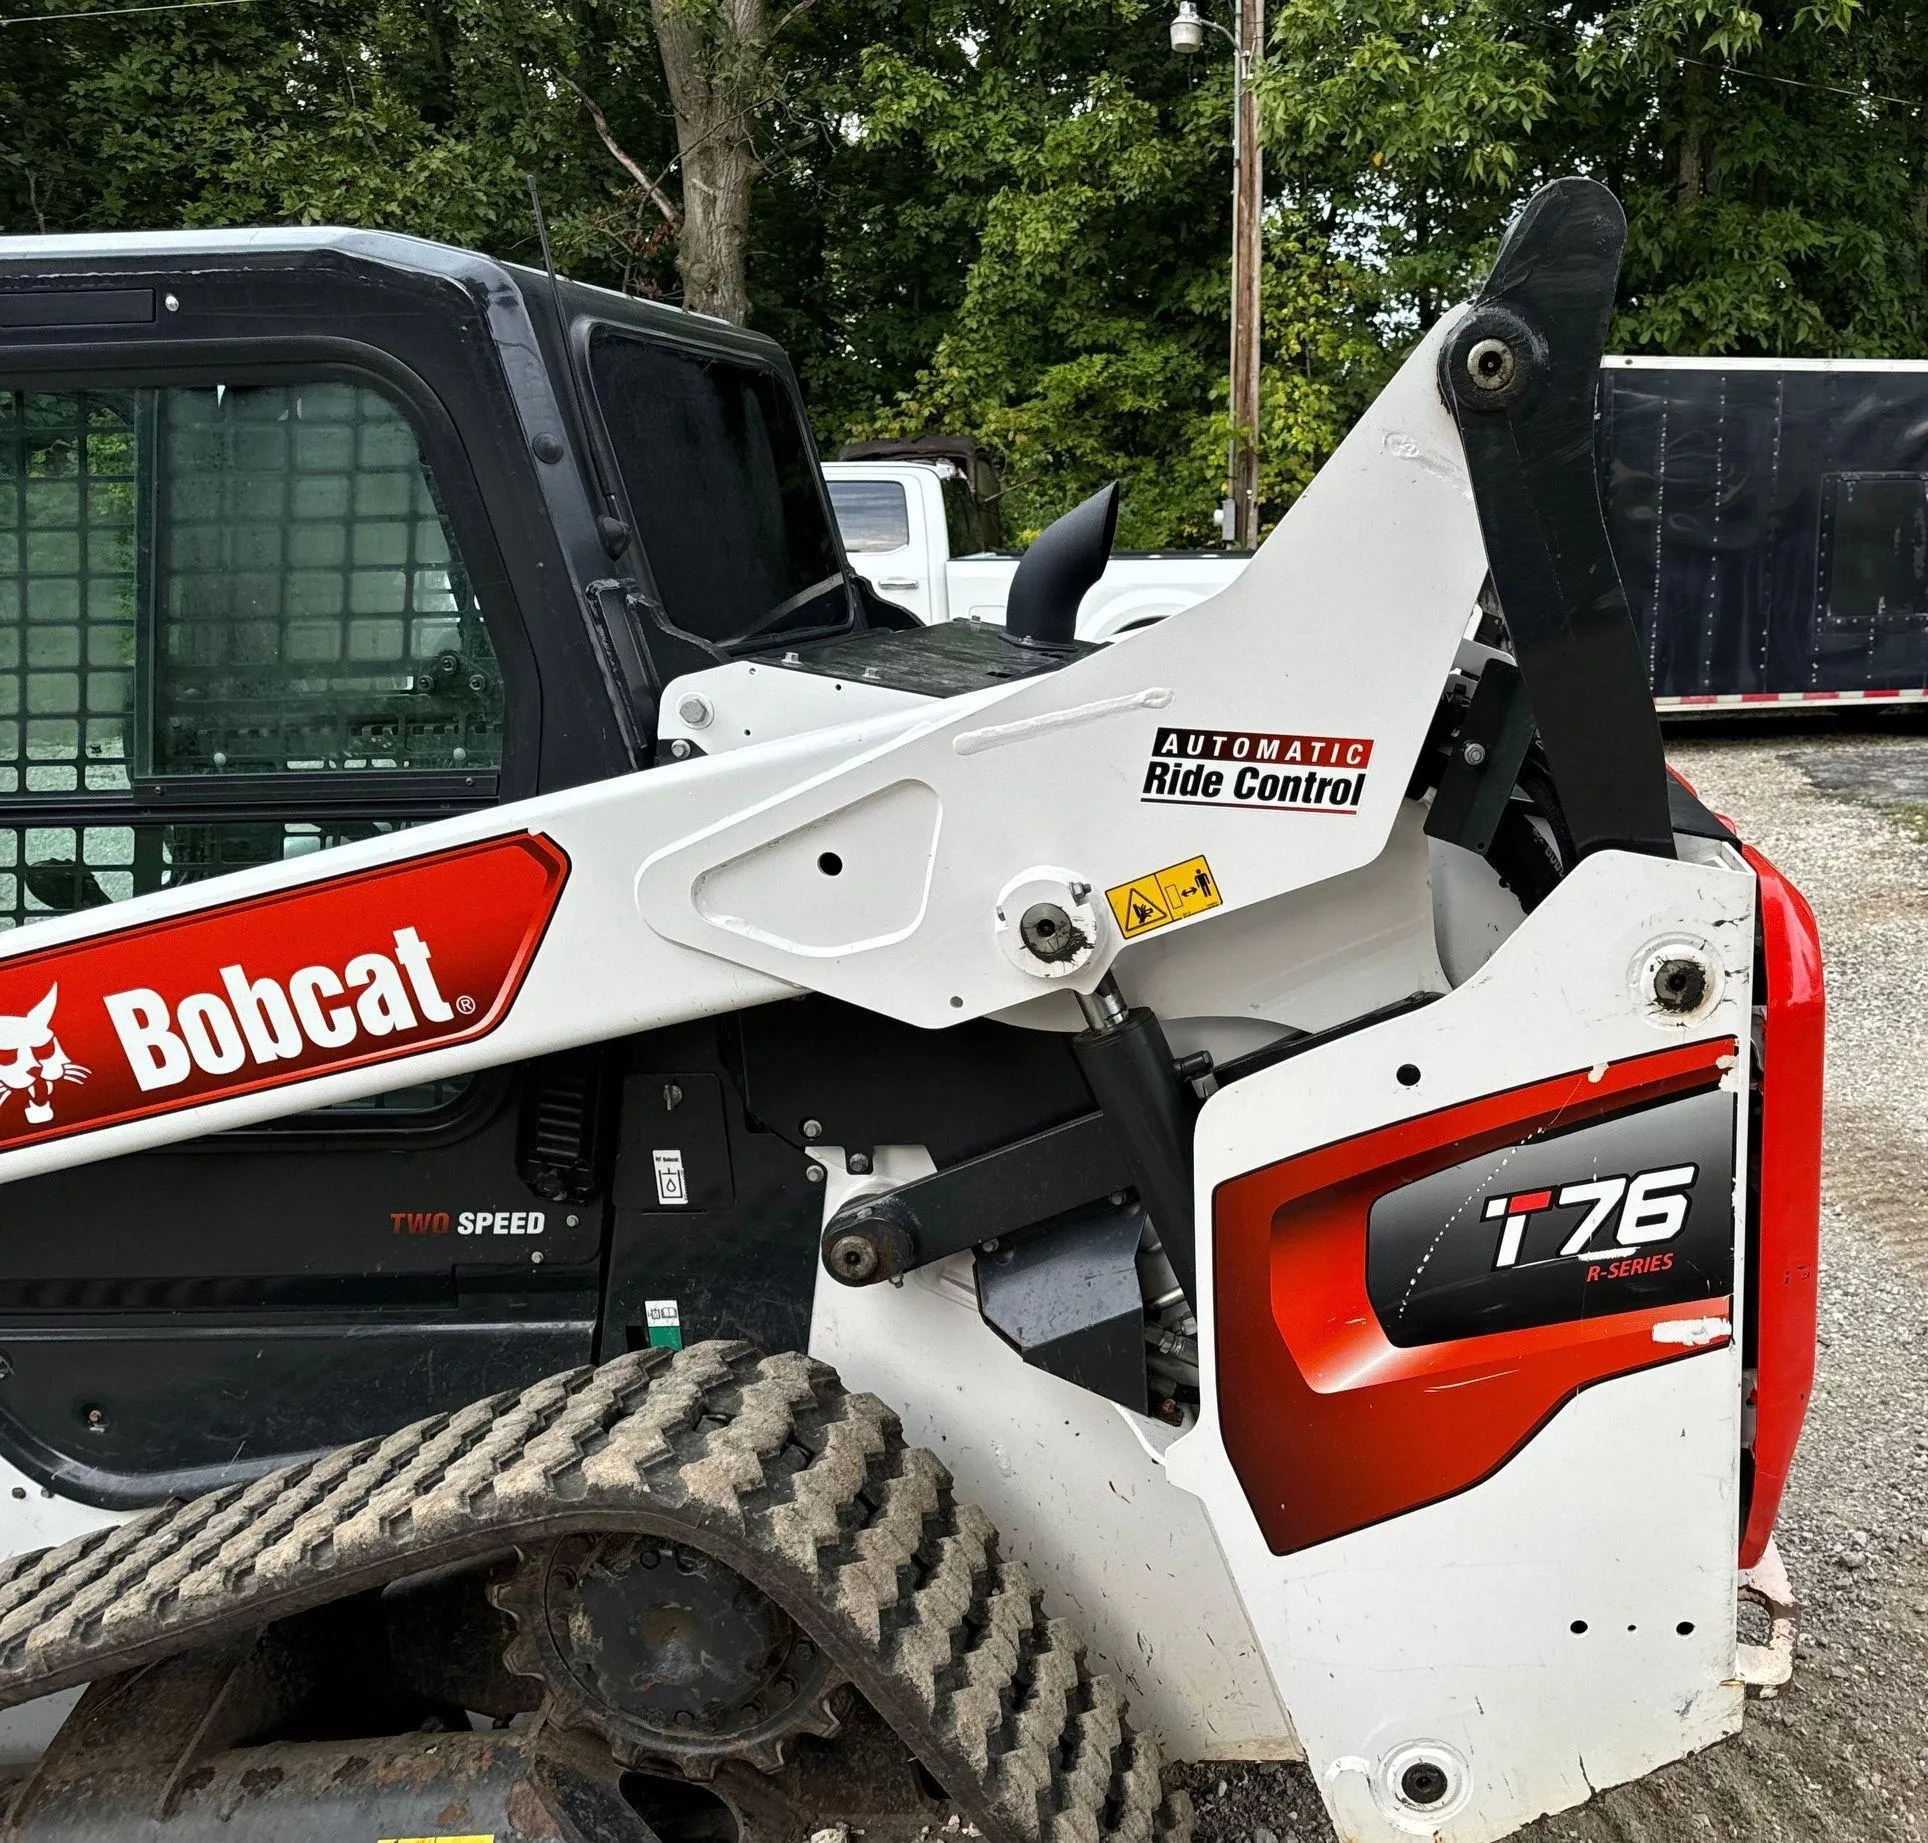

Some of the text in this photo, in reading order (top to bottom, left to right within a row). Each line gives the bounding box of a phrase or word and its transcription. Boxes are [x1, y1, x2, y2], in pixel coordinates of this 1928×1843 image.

[1161, 733, 1364, 765] AUTOMATIC
[1143, 761, 1366, 806] Ride Control
[390, 1212, 545, 1236] TWO SPEED
[1485, 1166, 1697, 1268] T76
[1587, 1253, 1674, 1282] R-SERIES
